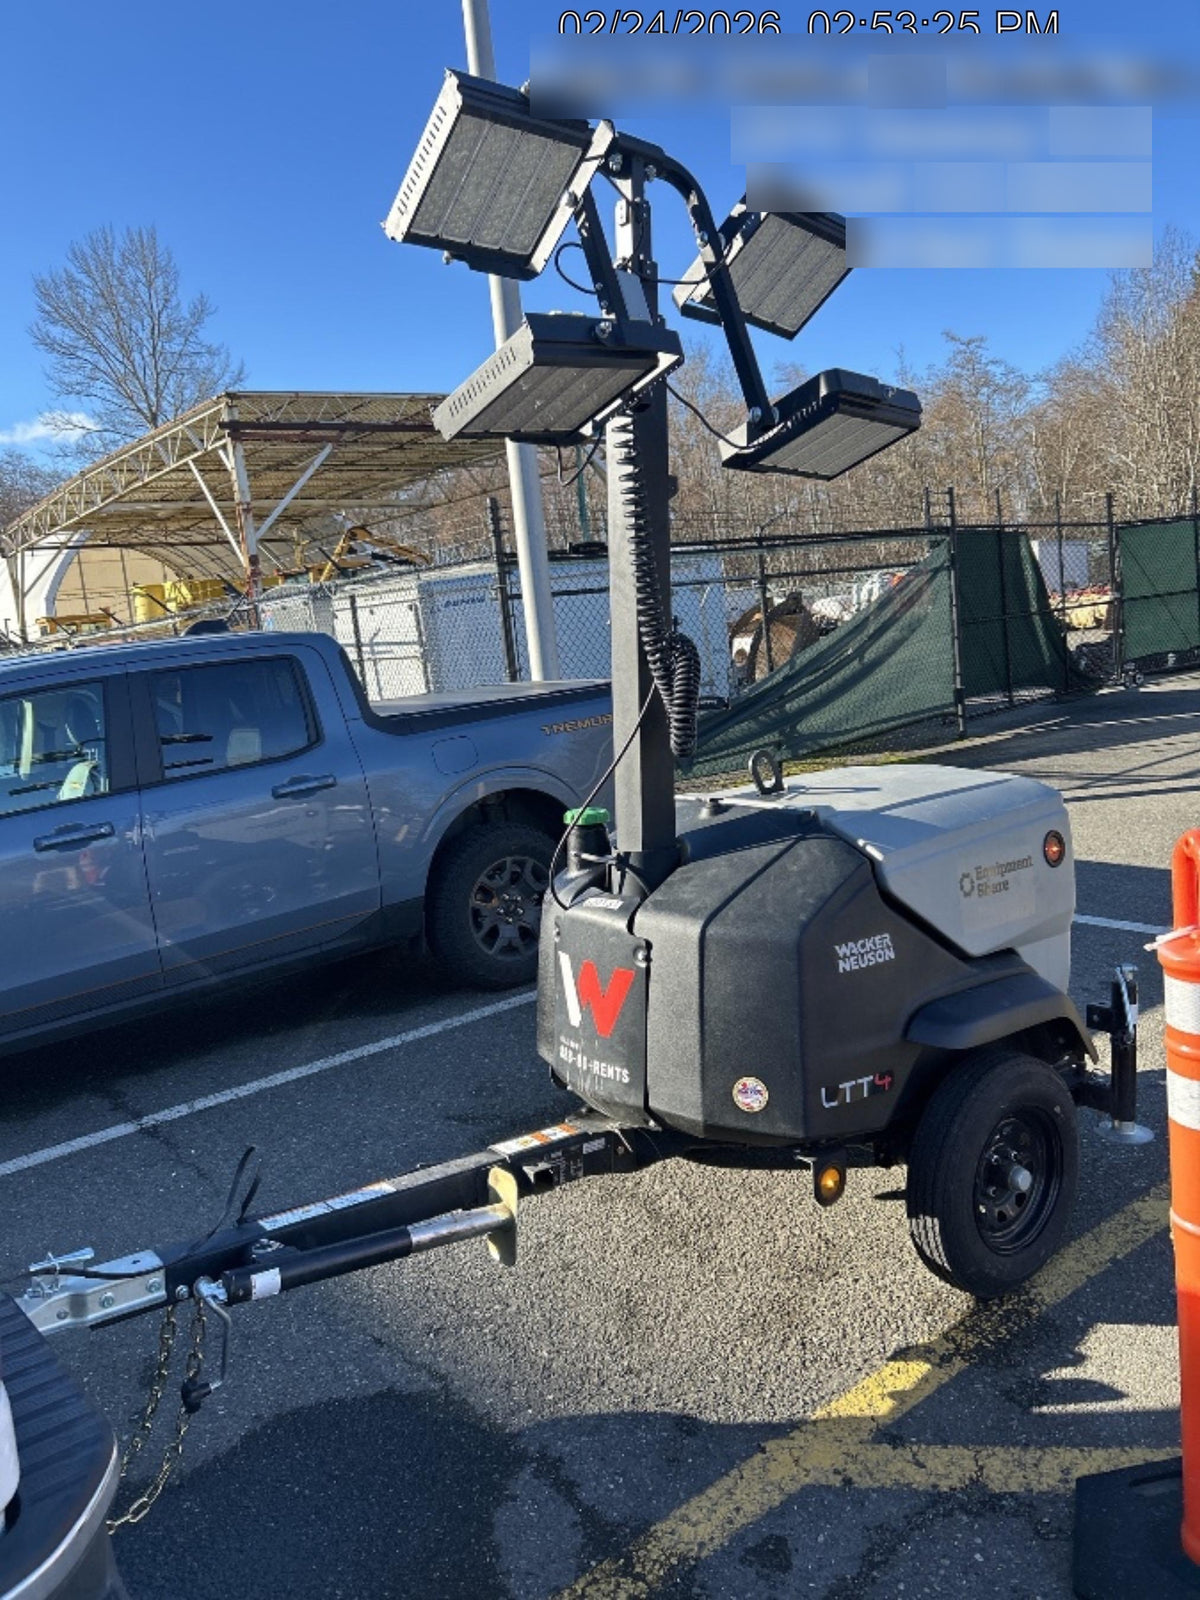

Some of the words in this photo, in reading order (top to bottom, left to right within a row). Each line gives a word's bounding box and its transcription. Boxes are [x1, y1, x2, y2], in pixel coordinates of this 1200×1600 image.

[974, 855, 1034, 881] Equipment
[976, 880, 1009, 898] Share
[833, 933, 892, 959] WACKER
[838, 947, 895, 973] NEUSON
[820, 1072, 893, 1109] LTT4
